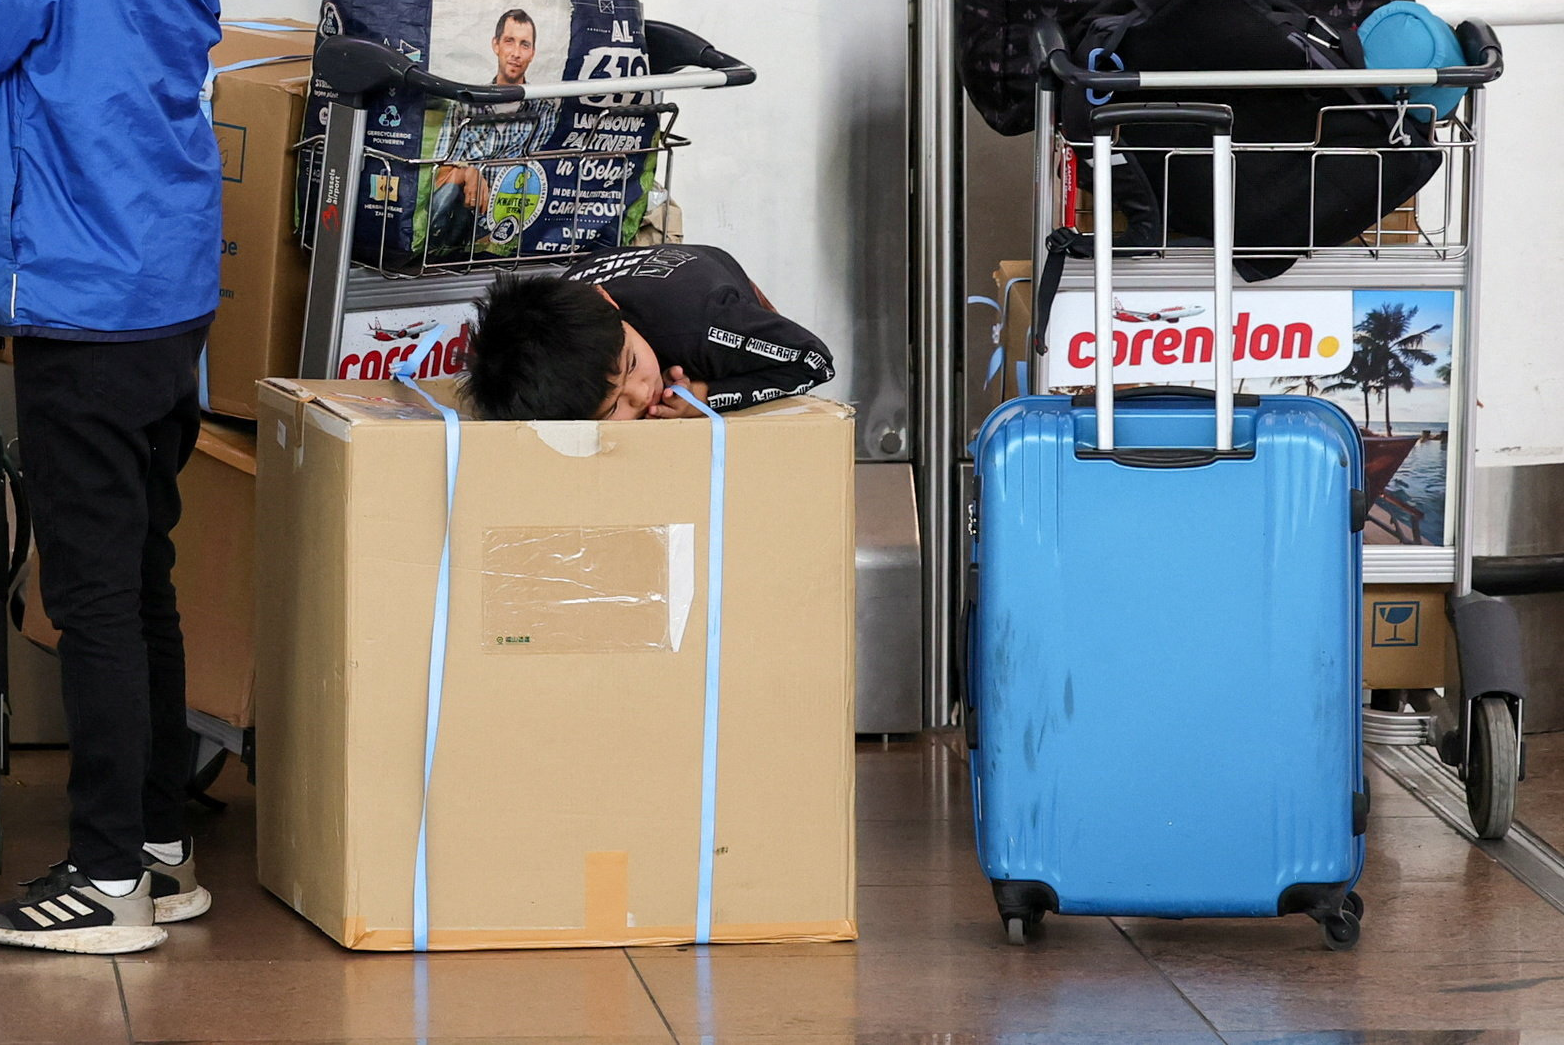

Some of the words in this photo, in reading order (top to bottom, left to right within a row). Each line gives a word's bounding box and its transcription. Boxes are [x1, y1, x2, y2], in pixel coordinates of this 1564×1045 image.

[611, 20, 633, 42] AL
[326, 168, 336, 203] brussels
[333, 175, 341, 205] airport
[536, 242, 559, 252] ACT
